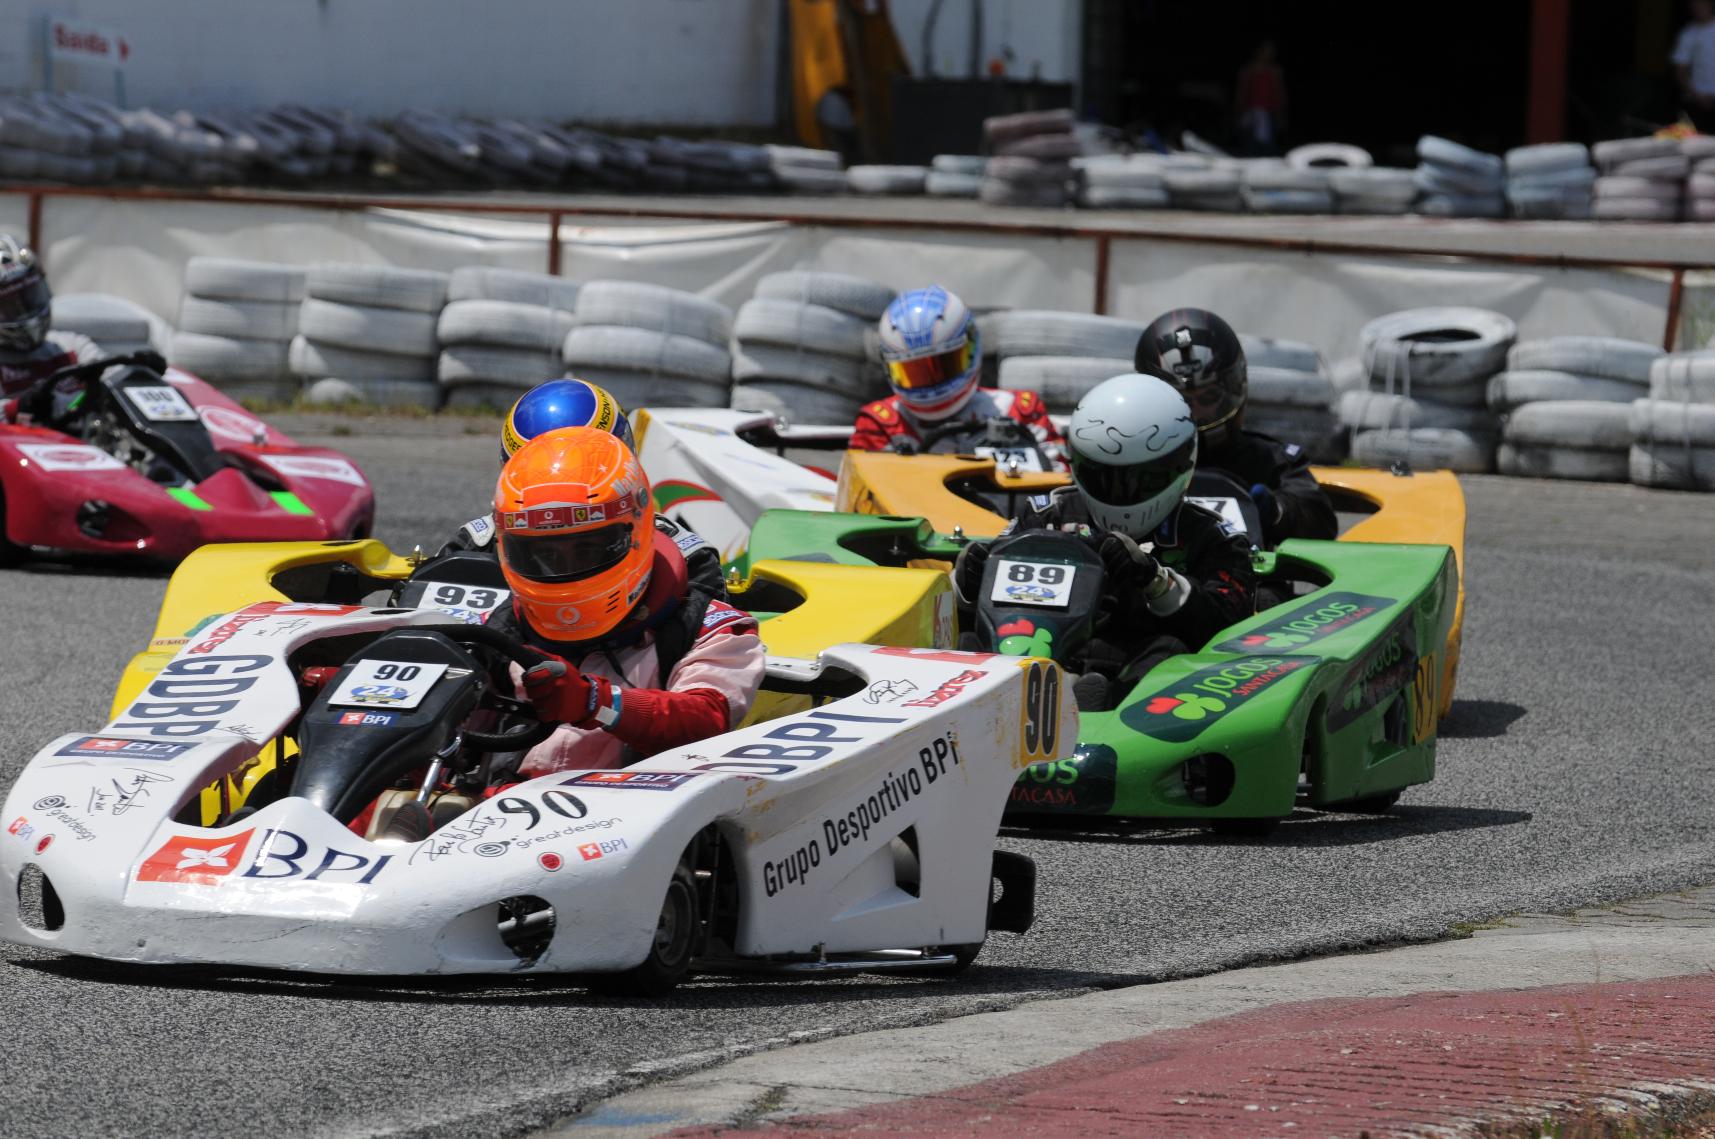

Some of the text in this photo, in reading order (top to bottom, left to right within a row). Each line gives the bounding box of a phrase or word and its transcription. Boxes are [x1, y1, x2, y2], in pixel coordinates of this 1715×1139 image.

[1008, 564, 1066, 585] 89
[434, 586, 499, 609] 93
[1281, 602, 1358, 635] JOGOS
[373, 664, 421, 681] 90
[1193, 658, 1283, 698] JOGOS
[361, 714, 392, 725] BPI
[1026, 662, 1058, 755] 90
[121, 741, 182, 753] BPI
[626, 774, 684, 782] BPI
[497, 791, 588, 831] 90
[515, 816, 623, 850] greatdesign
[763, 838, 821, 898] Grupo
[822, 765, 922, 857] Desportivo
[242, 828, 396, 885] BPI
[601, 837, 629, 855] BPI
